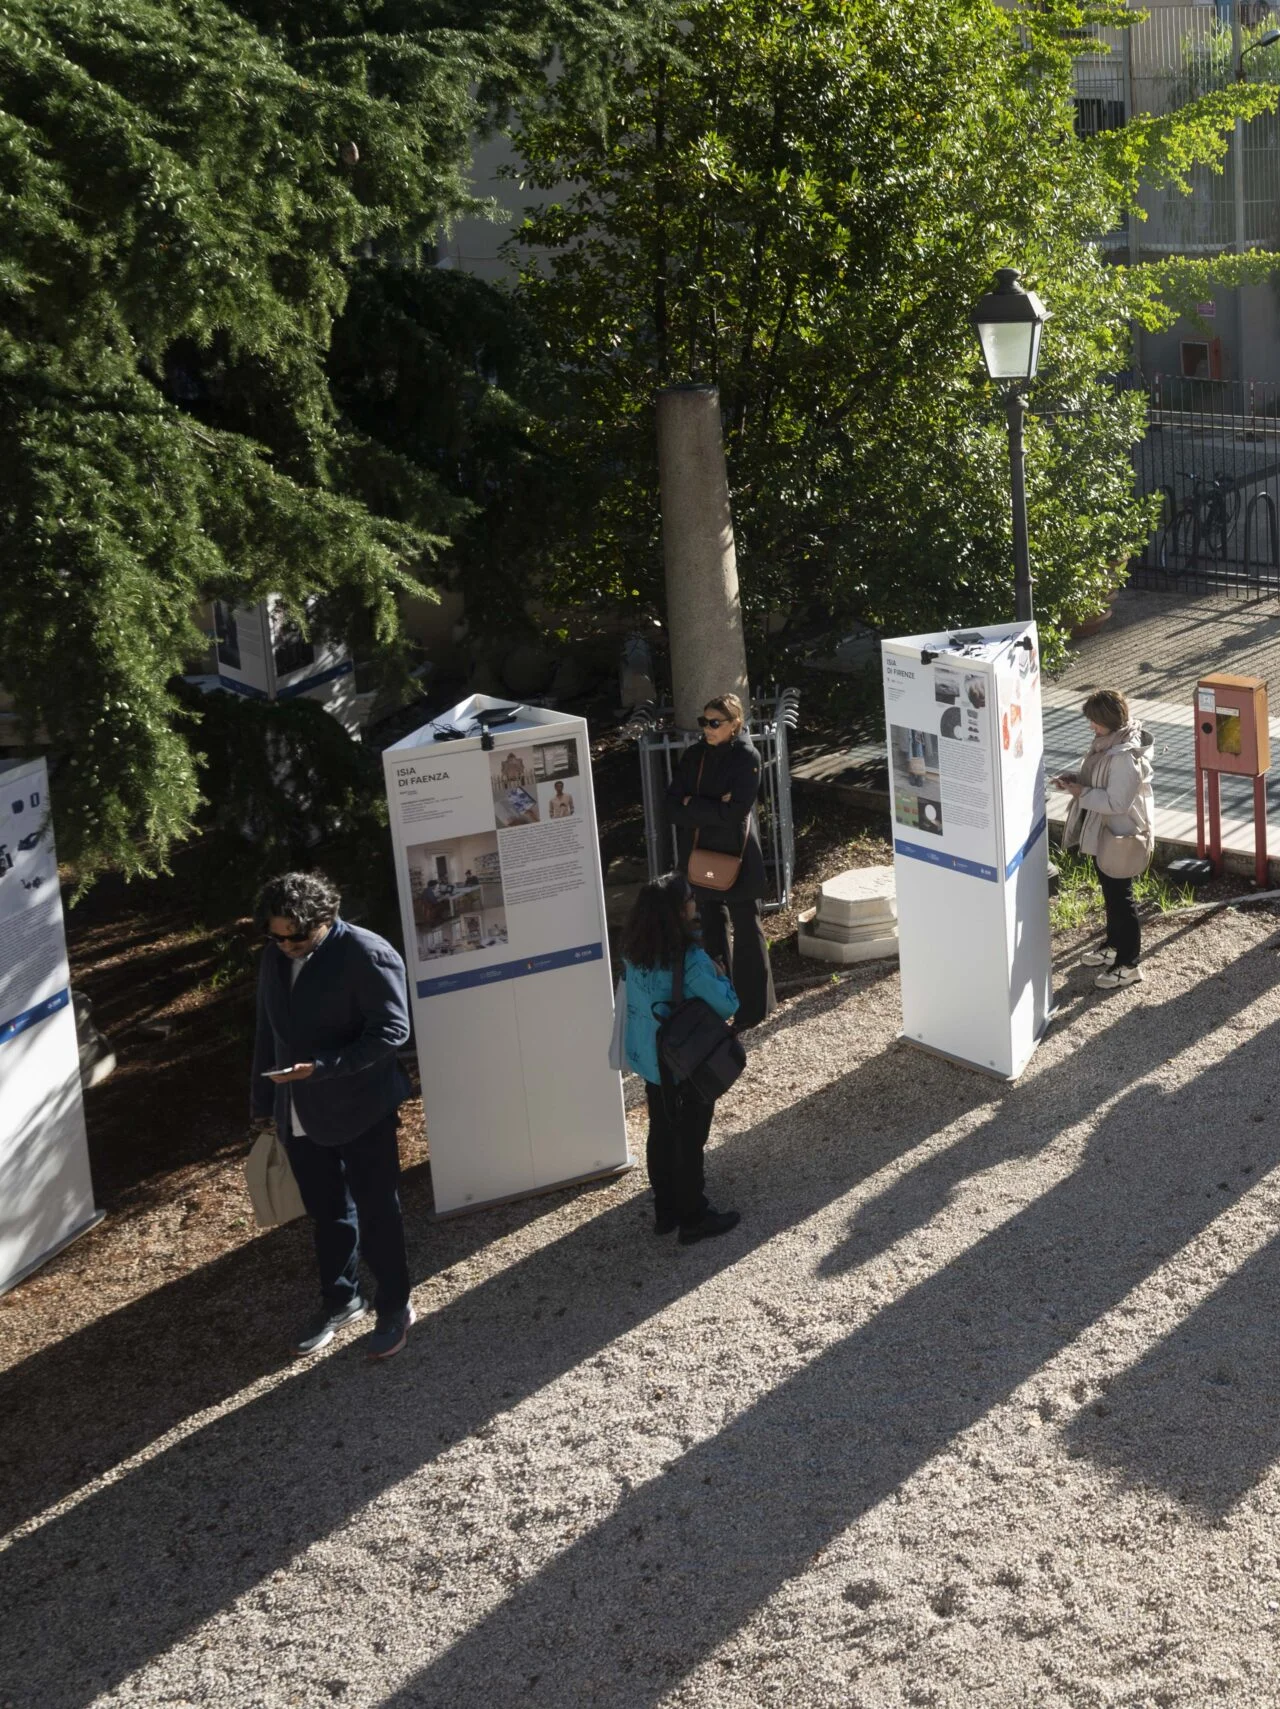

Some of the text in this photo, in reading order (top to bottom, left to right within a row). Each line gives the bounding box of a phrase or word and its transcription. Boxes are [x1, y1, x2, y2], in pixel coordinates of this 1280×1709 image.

[894, 669, 915, 679] FIRENZE
[397, 767, 416, 777] ISIA
[398, 772, 450, 787] DI FAENZA
